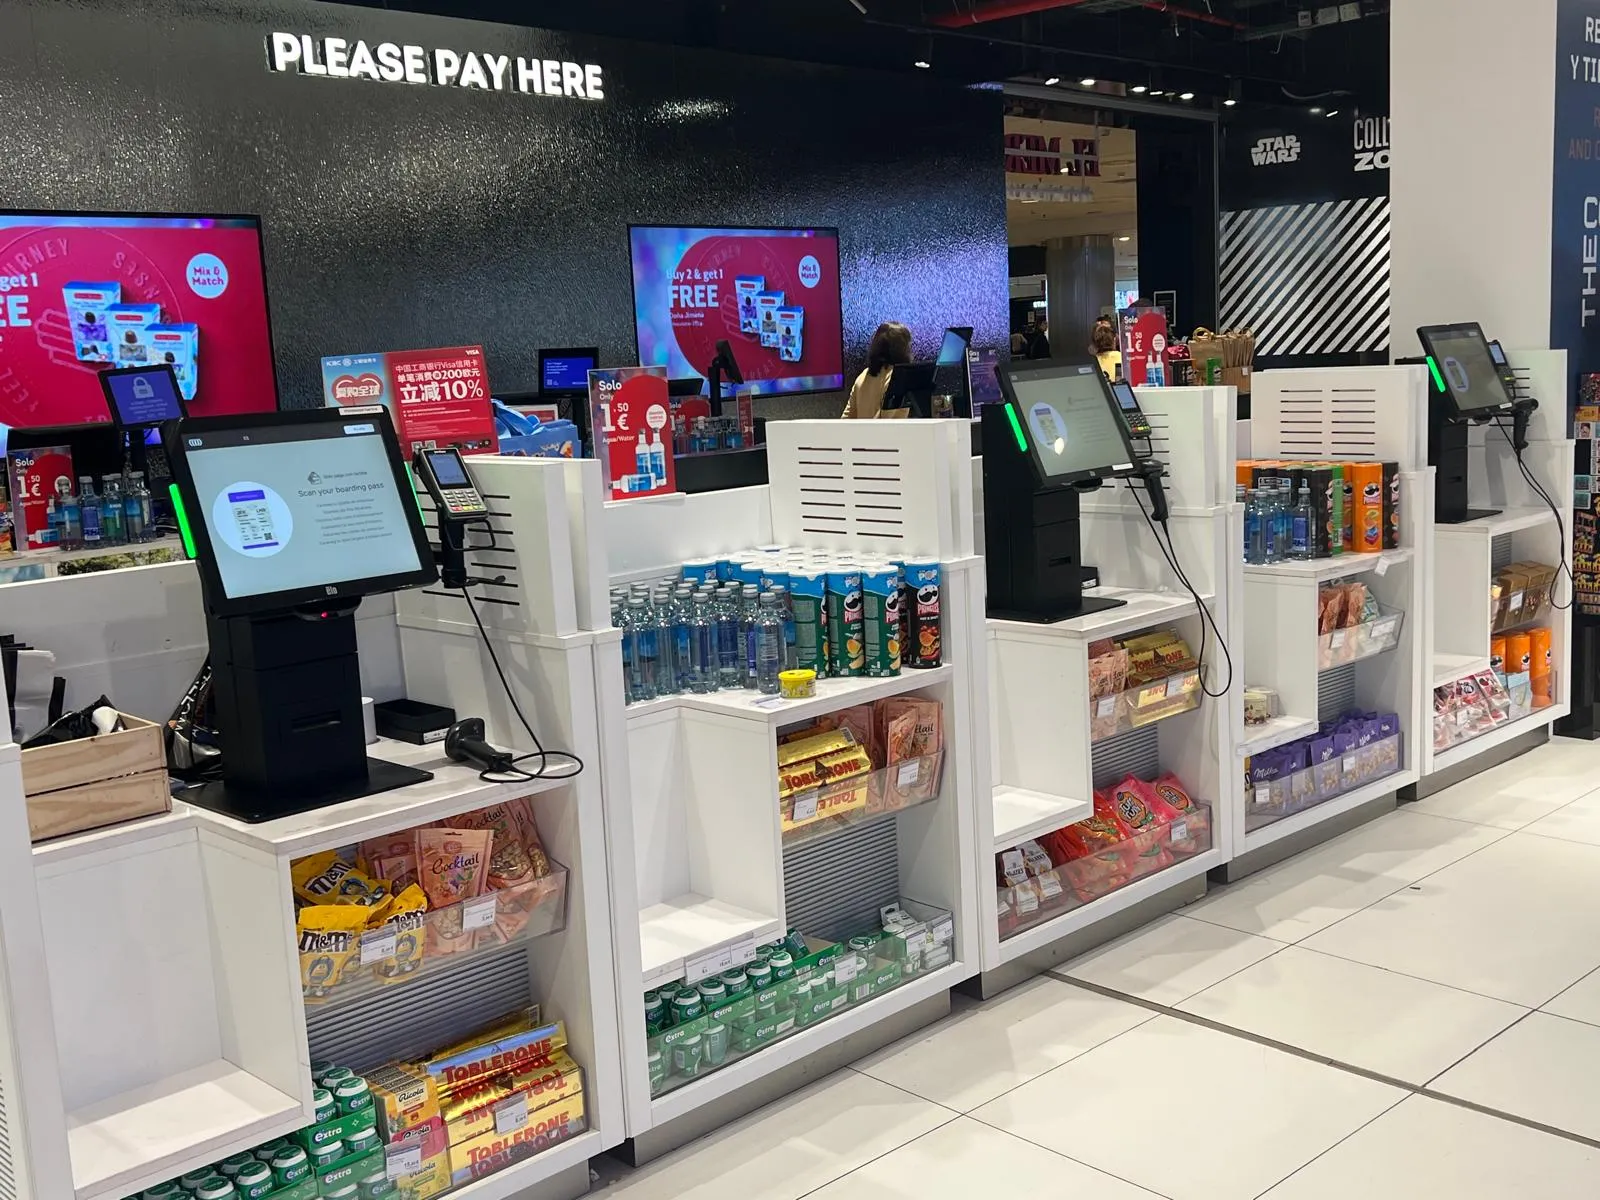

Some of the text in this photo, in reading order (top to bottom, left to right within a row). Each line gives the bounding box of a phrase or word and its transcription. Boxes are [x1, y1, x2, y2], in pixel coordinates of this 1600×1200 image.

[270, 31, 605, 101] PLEASE PAY HERE
[1570, 53, 1579, 80] Y
[1251, 134, 1301, 153] STAR
[1251, 148, 1301, 166] WARS
[193, 267, 213, 276] Mix
[686, 268, 692, 280] 2
[694, 268, 702, 280] &
[703, 269, 718, 283] get
[1, 273, 28, 292] get
[192, 275, 225, 287] Match
[1581, 234, 1598, 327] THE
[667, 284, 720, 309] FREE
[1124, 315, 1139, 324] Solo
[399, 379, 484, 404] 立减10%
[598, 380, 622, 391] Solo
[599, 392, 614, 402] Only
[617, 413, 629, 431] €
[15, 458, 35, 467] Solo
[31, 483, 41, 497] €
[298, 482, 385, 498] Scan your boarding pass
[1254, 767, 1279, 778] Milka
[464, 807, 505, 831] Cocktail
[431, 852, 480, 875] Cocktail
[759, 990, 777, 1002] extra
[713, 1006, 733, 1019] extra
[665, 1030, 685, 1043] extra
[441, 1037, 553, 1085] TOBLERONE
[398, 1087, 425, 1103] Ricola
[314, 1127, 343, 1142] extra
[466, 1110, 570, 1168] TOBLERONE
[286, 1163, 309, 1179] extra
[325, 1167, 352, 1184] extra
[250, 1182, 273, 1197] extra
